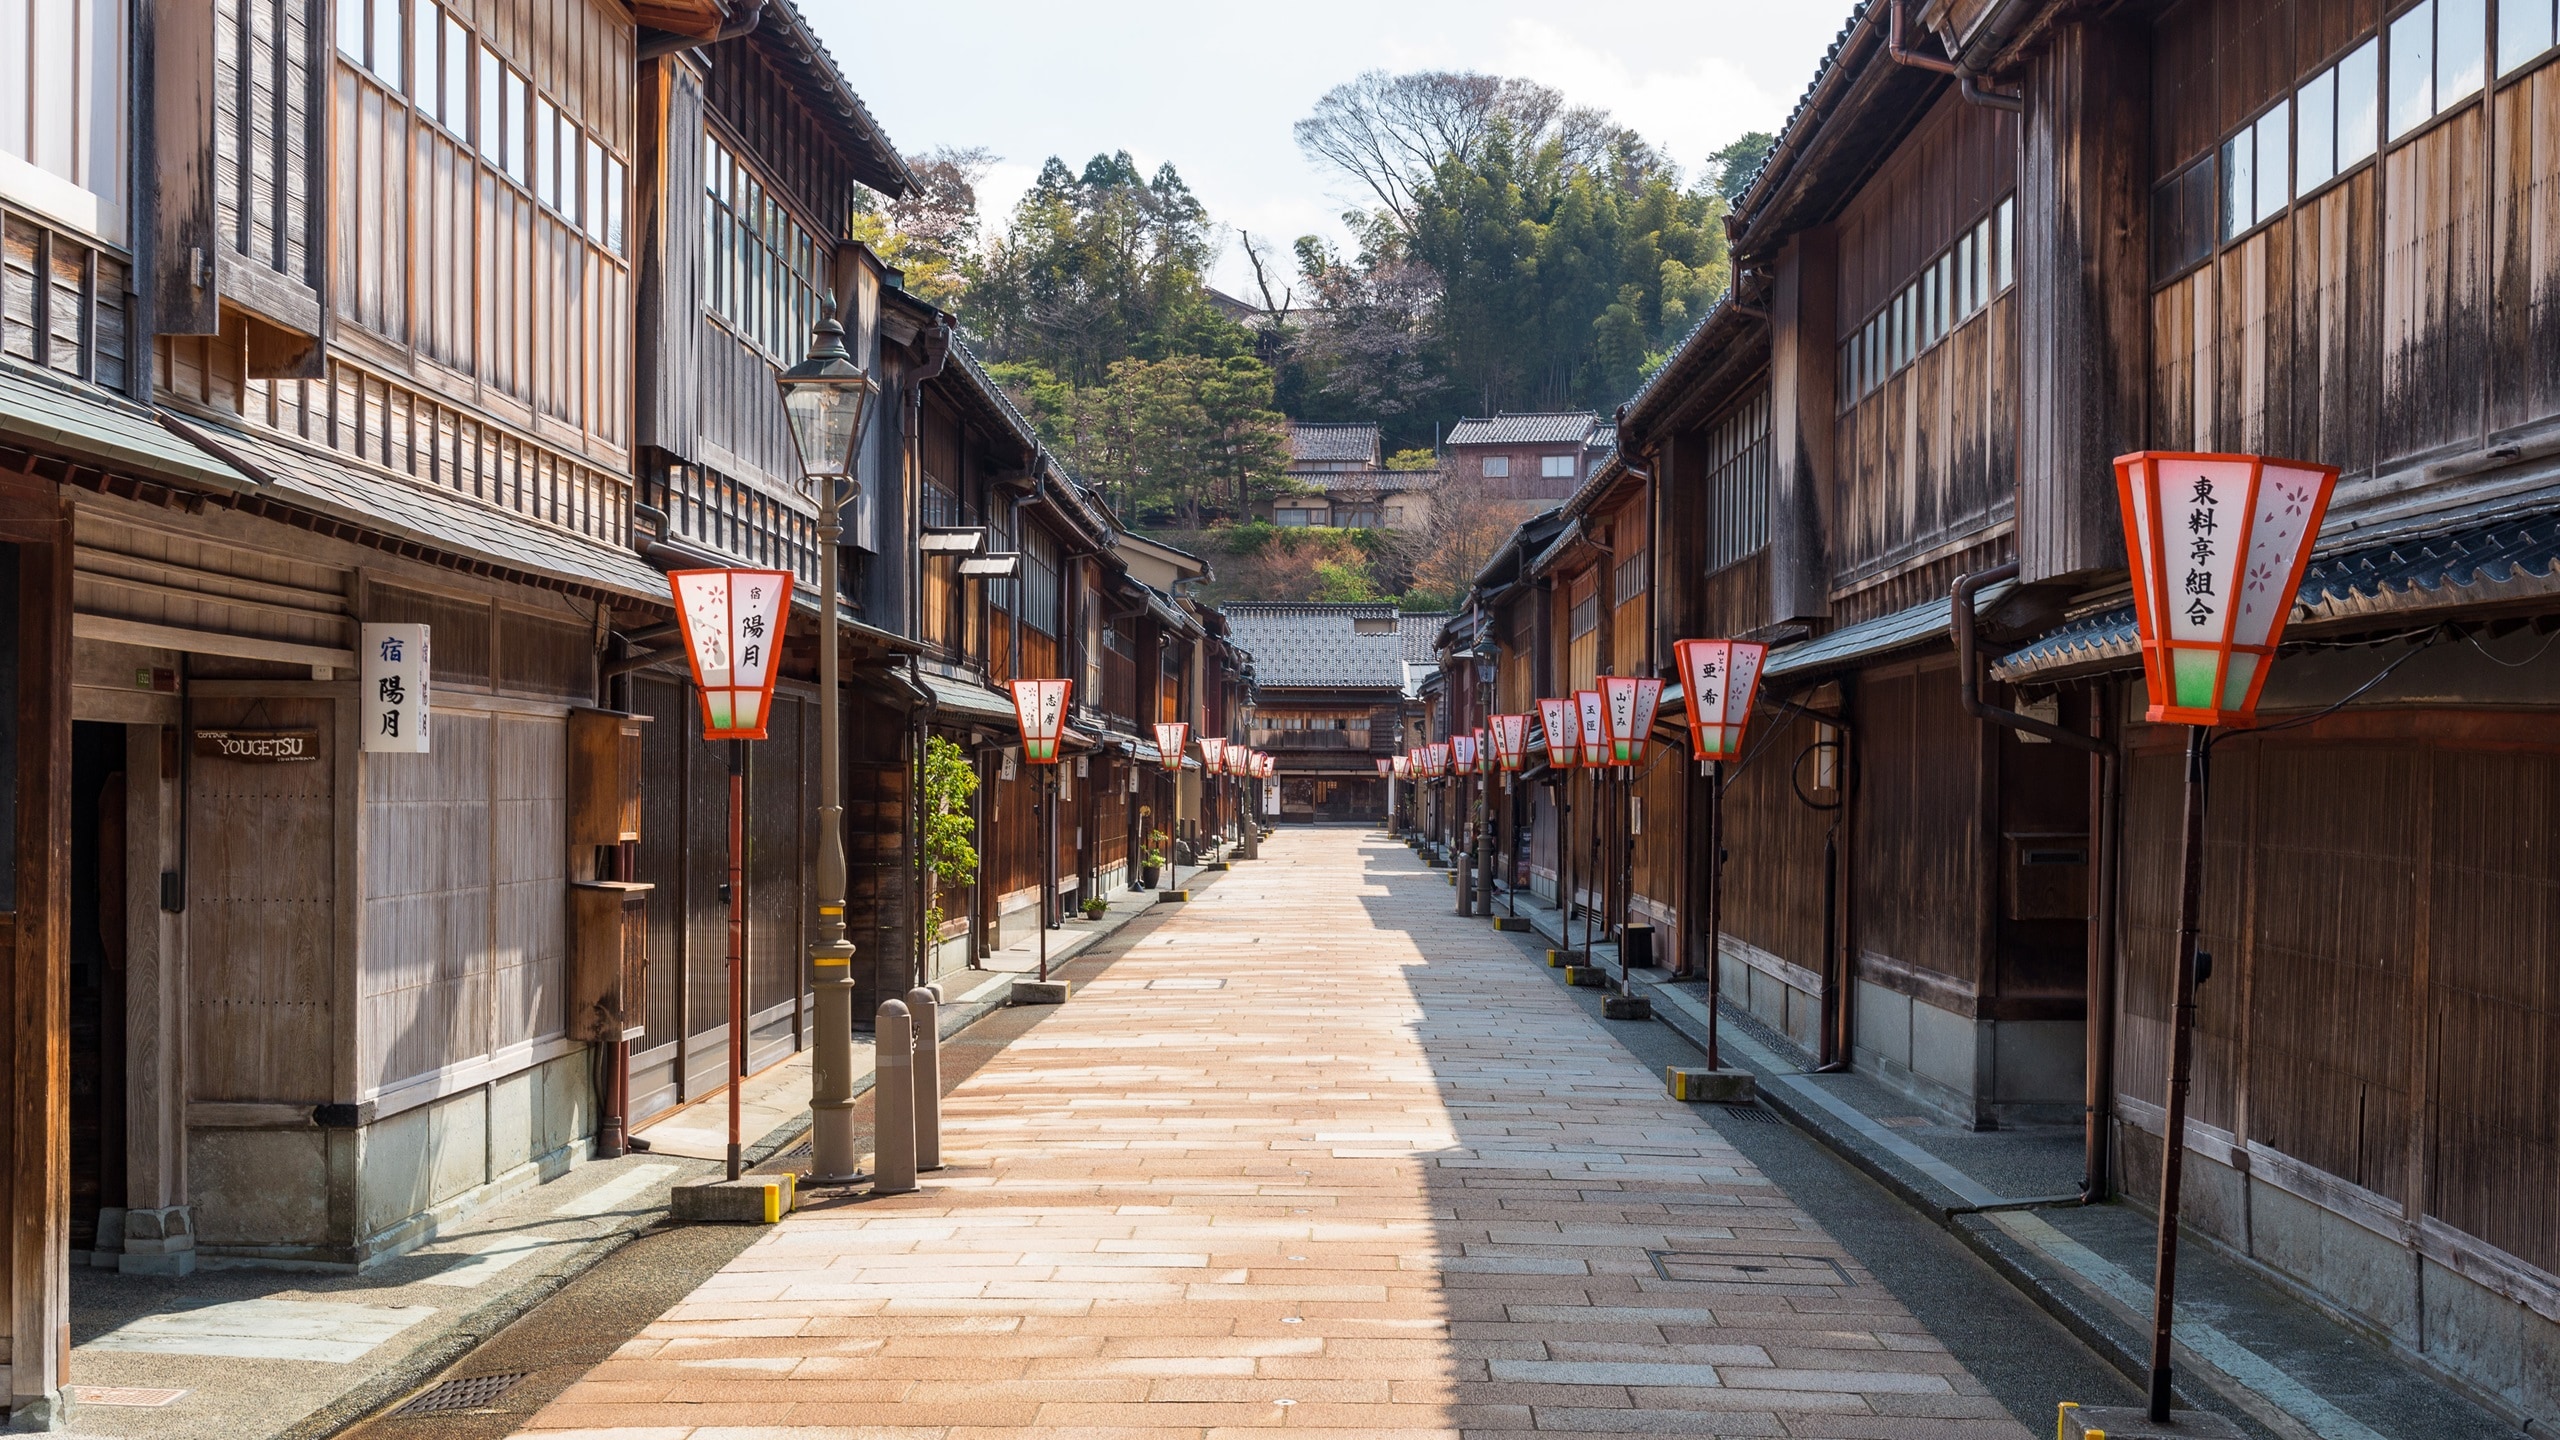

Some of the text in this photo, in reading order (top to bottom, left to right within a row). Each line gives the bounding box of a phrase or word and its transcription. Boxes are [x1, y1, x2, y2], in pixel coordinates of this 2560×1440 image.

[2185, 475, 2219, 626] 東料亭組合
[742, 587, 765, 668] 宿・陽月
[1717, 649, 1725, 672] 山とみ
[1702, 662, 1718, 706] 亜希
[1044, 694, 1057, 726] 志摩
[1549, 710, 1559, 738] 中むら
[1616, 692, 1627, 726] 山とみ
[217, 737, 303, 757] YOUGETSU
